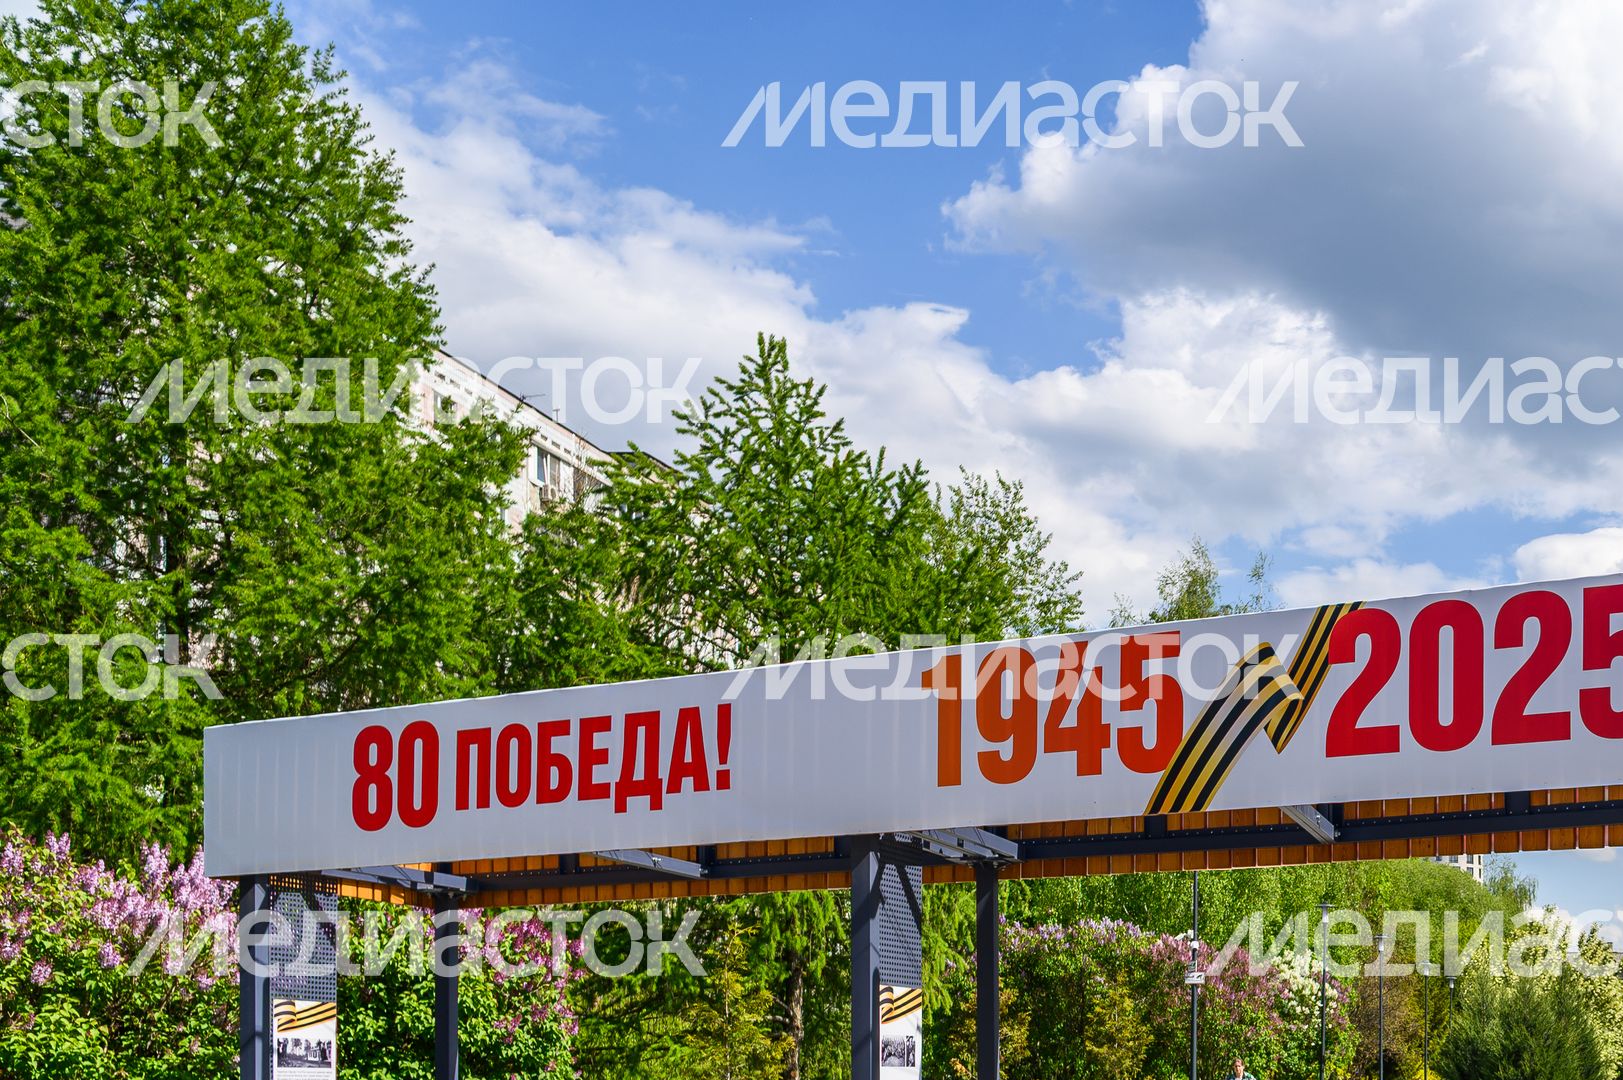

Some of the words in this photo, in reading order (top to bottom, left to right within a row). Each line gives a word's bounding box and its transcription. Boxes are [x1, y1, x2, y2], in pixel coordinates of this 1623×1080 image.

[352, 721, 440, 832] 80
[455, 704, 732, 814] ПОБЕДА!
[921, 630, 1184, 787] 1945
